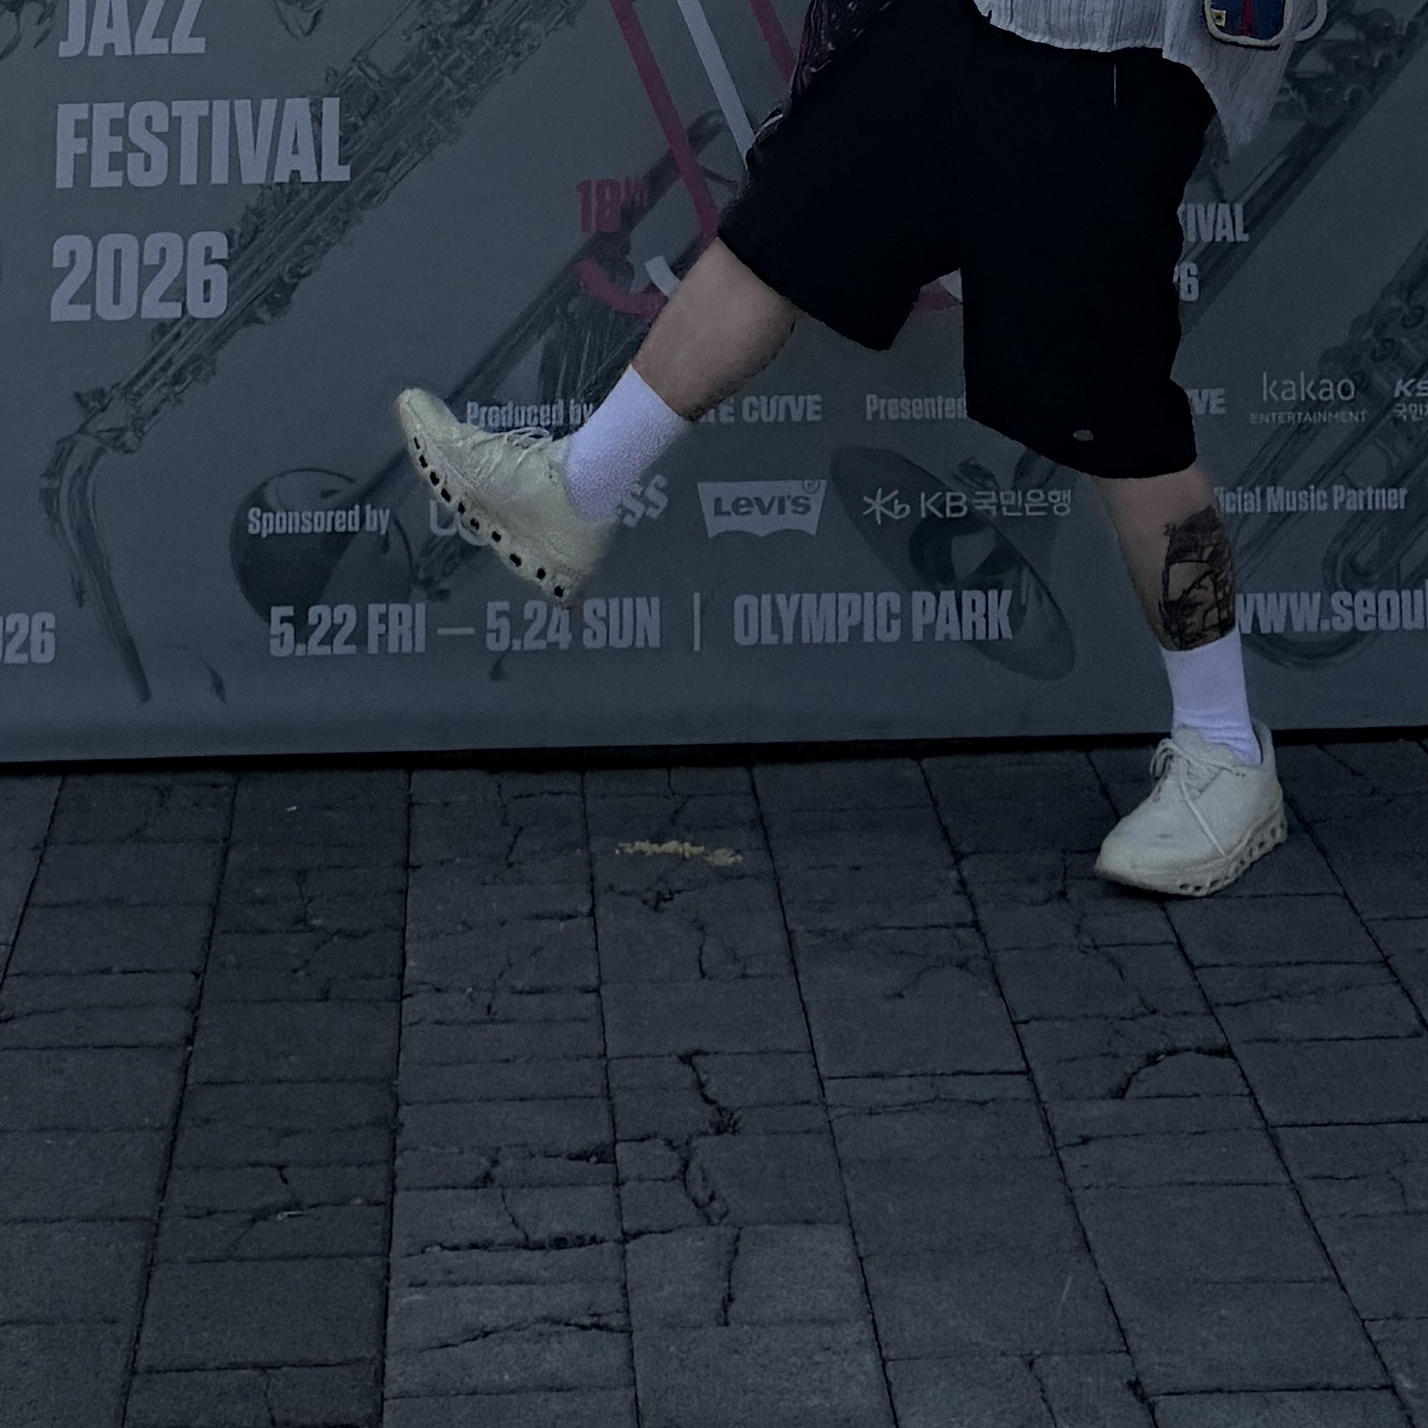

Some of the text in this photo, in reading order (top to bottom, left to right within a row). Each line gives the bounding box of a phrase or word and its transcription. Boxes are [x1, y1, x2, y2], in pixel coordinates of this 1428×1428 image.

[56, 96, 351, 189] FESTIVAL
[50, 231, 229, 322] 2026
[1262, 371, 1355, 402] kakao
[467, 398, 565, 428] Produced
[1249, 410, 1367, 424] ENTERTAINMENT
[1266, 484, 1328, 512] Music
[1333, 484, 1408, 511] Partner
[248, 504, 390, 538] Sponsored by
[270, 604, 357, 657] 5.22
[367, 603, 426, 655] FRI
[485, 600, 572, 652] 5.24
[582, 597, 661, 649] SUN
[734, 589, 1013, 646] OLYMPIC PARK
